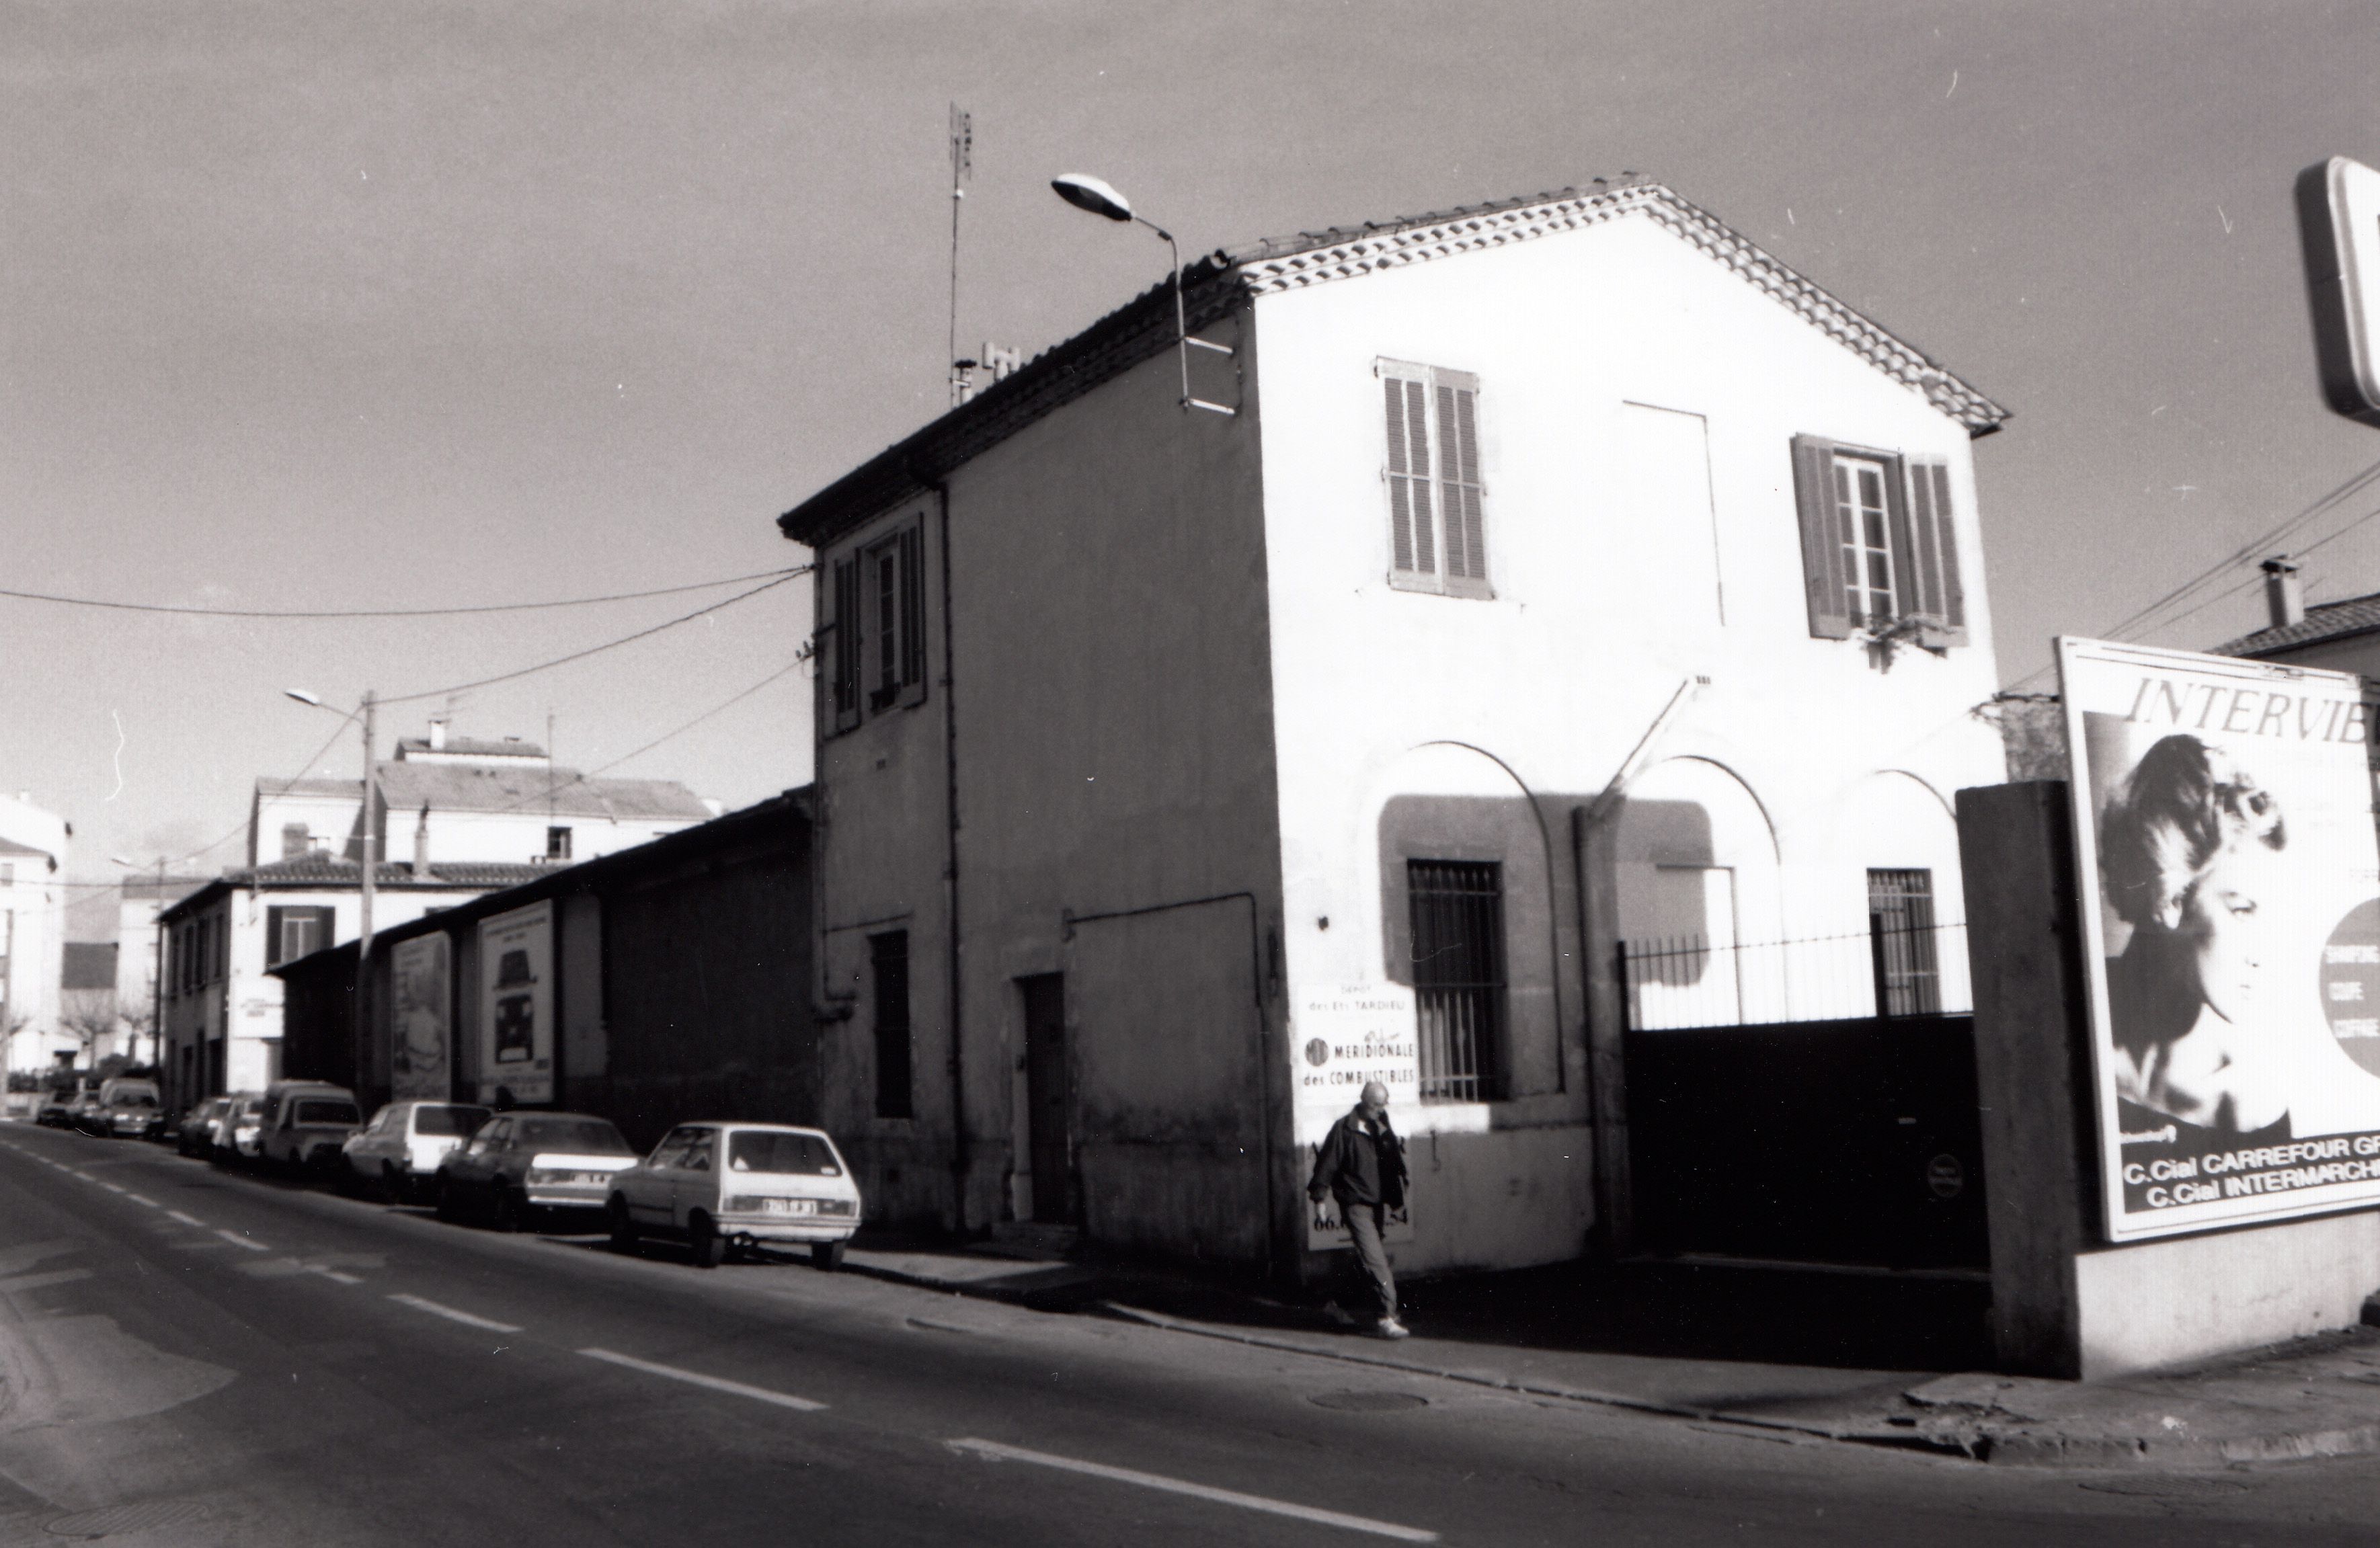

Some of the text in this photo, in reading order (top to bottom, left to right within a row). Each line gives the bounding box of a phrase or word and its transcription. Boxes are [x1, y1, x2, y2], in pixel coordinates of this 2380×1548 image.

[2123, 677, 2380, 745] INTERVIE
[1355, 1000, 1404, 1010] TARDIEU
[1335, 1043, 1413, 1059] MERIDIONALE
[1304, 1069, 1413, 1086] des COMBUSTIBLES
[2123, 1155, 2198, 1184] C.Cial
[2202, 1137, 2351, 1174] CARREFOUR
[2146, 1180, 2221, 1207] C.Cial
